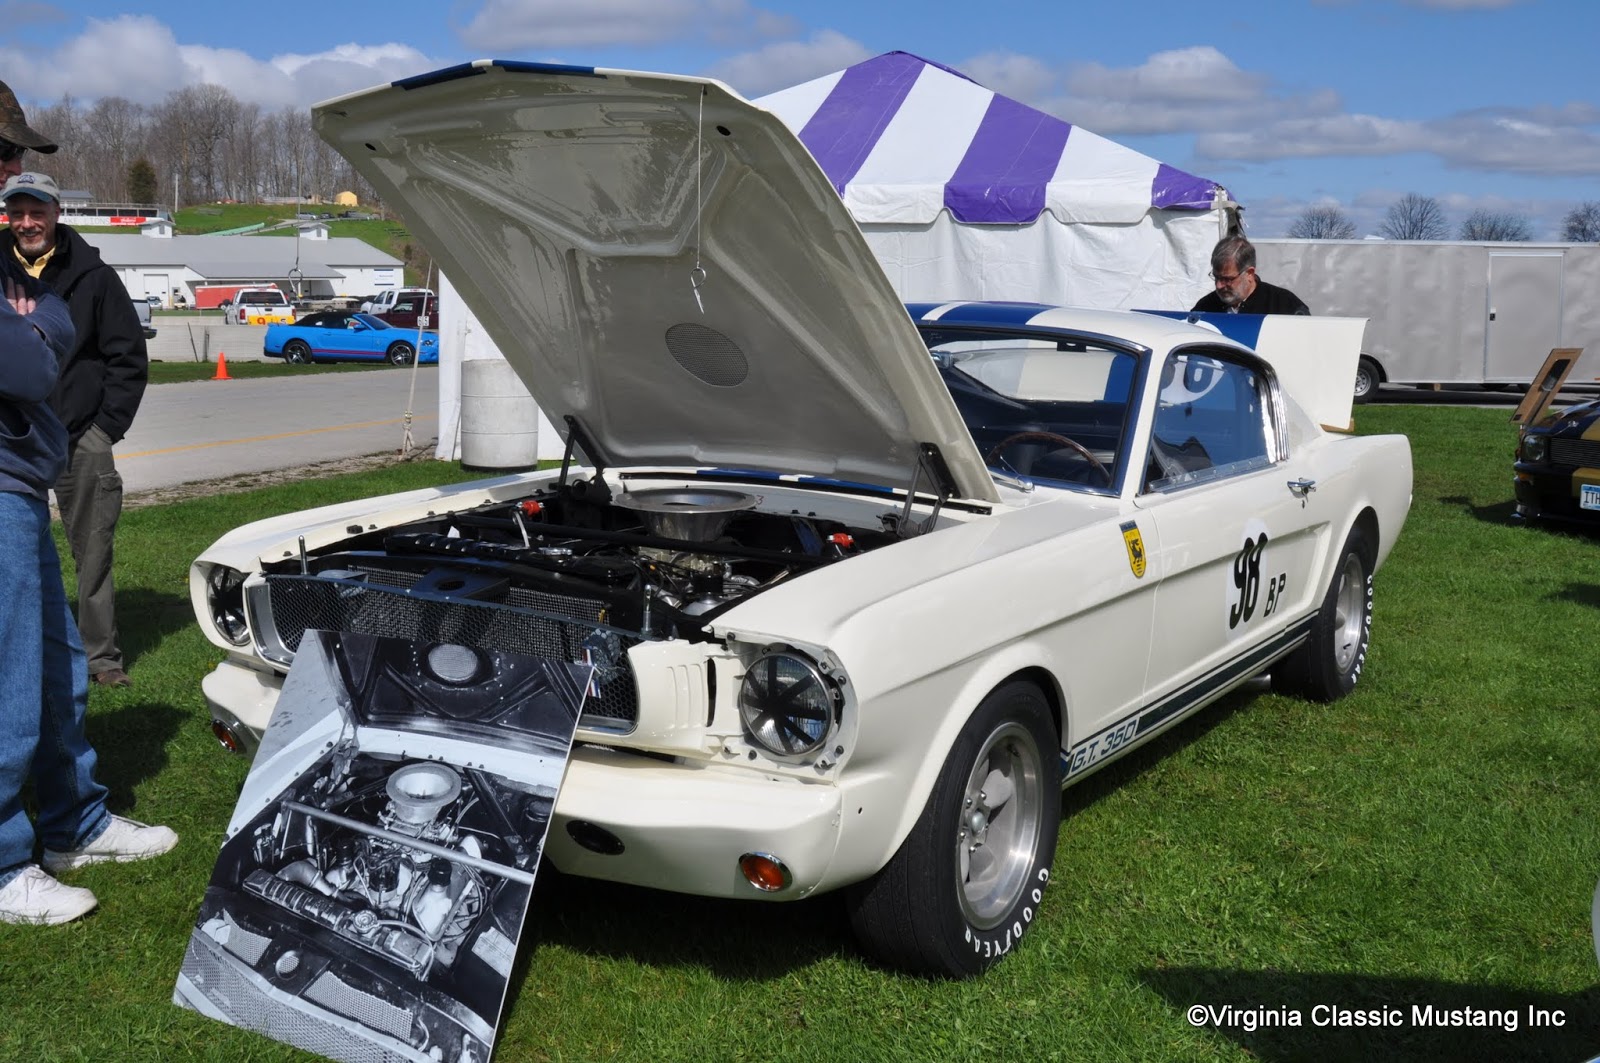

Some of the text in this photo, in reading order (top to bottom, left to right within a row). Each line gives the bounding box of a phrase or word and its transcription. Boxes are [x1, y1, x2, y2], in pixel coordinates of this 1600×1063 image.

[1229, 532, 1286, 629] 98 BP
[1071, 719, 1137, 772] G.T. 350
[965, 867, 1049, 958] GOODYEAR
